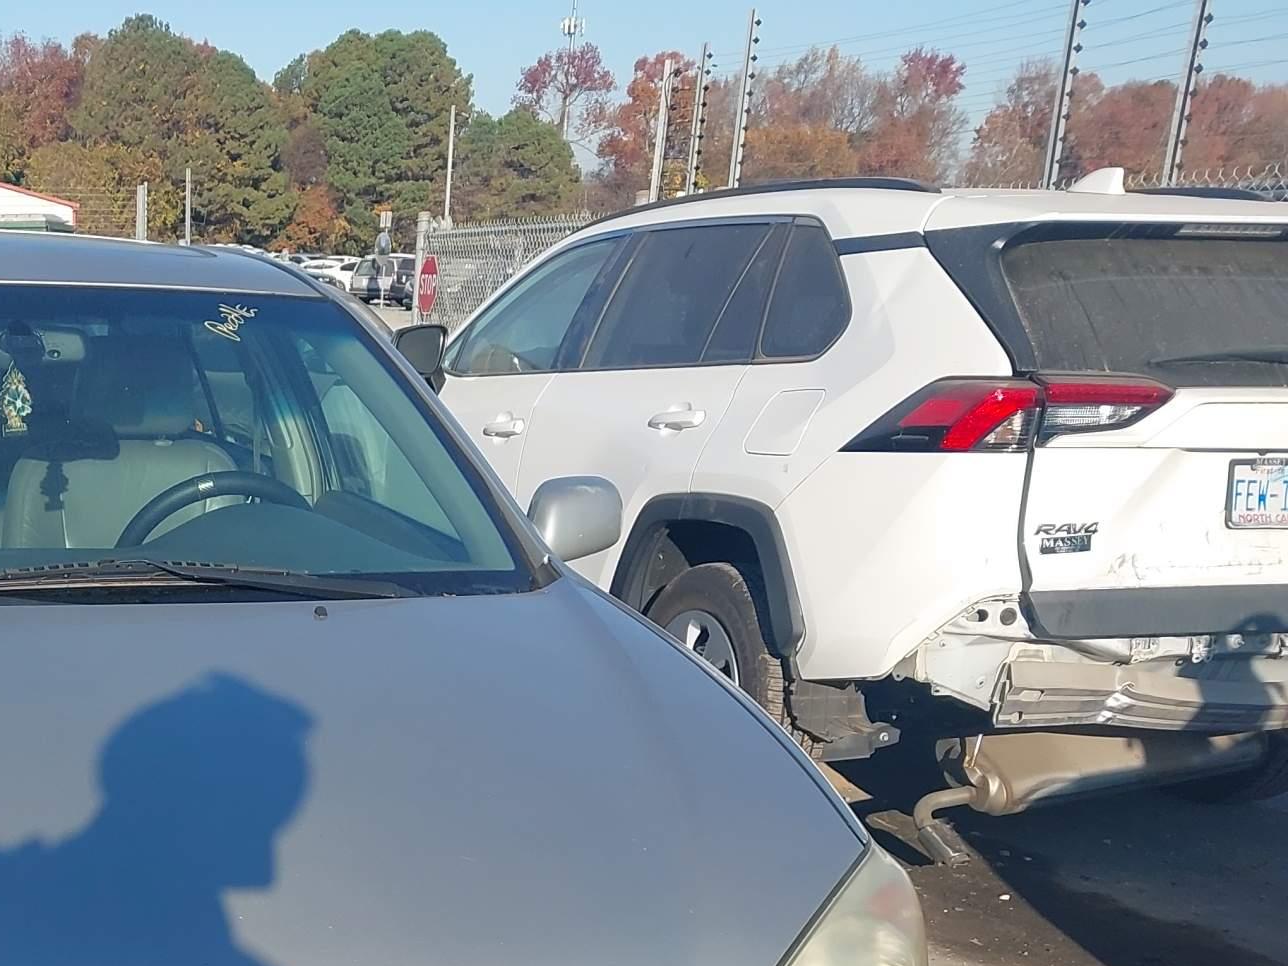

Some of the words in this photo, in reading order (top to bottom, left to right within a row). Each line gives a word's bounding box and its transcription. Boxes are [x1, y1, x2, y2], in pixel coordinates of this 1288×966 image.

[419, 273, 437, 295] STOP
[1238, 513, 1271, 524] NORTH
[1033, 522, 1099, 536] RAV4
[1042, 535, 1089, 549] MASSEY
